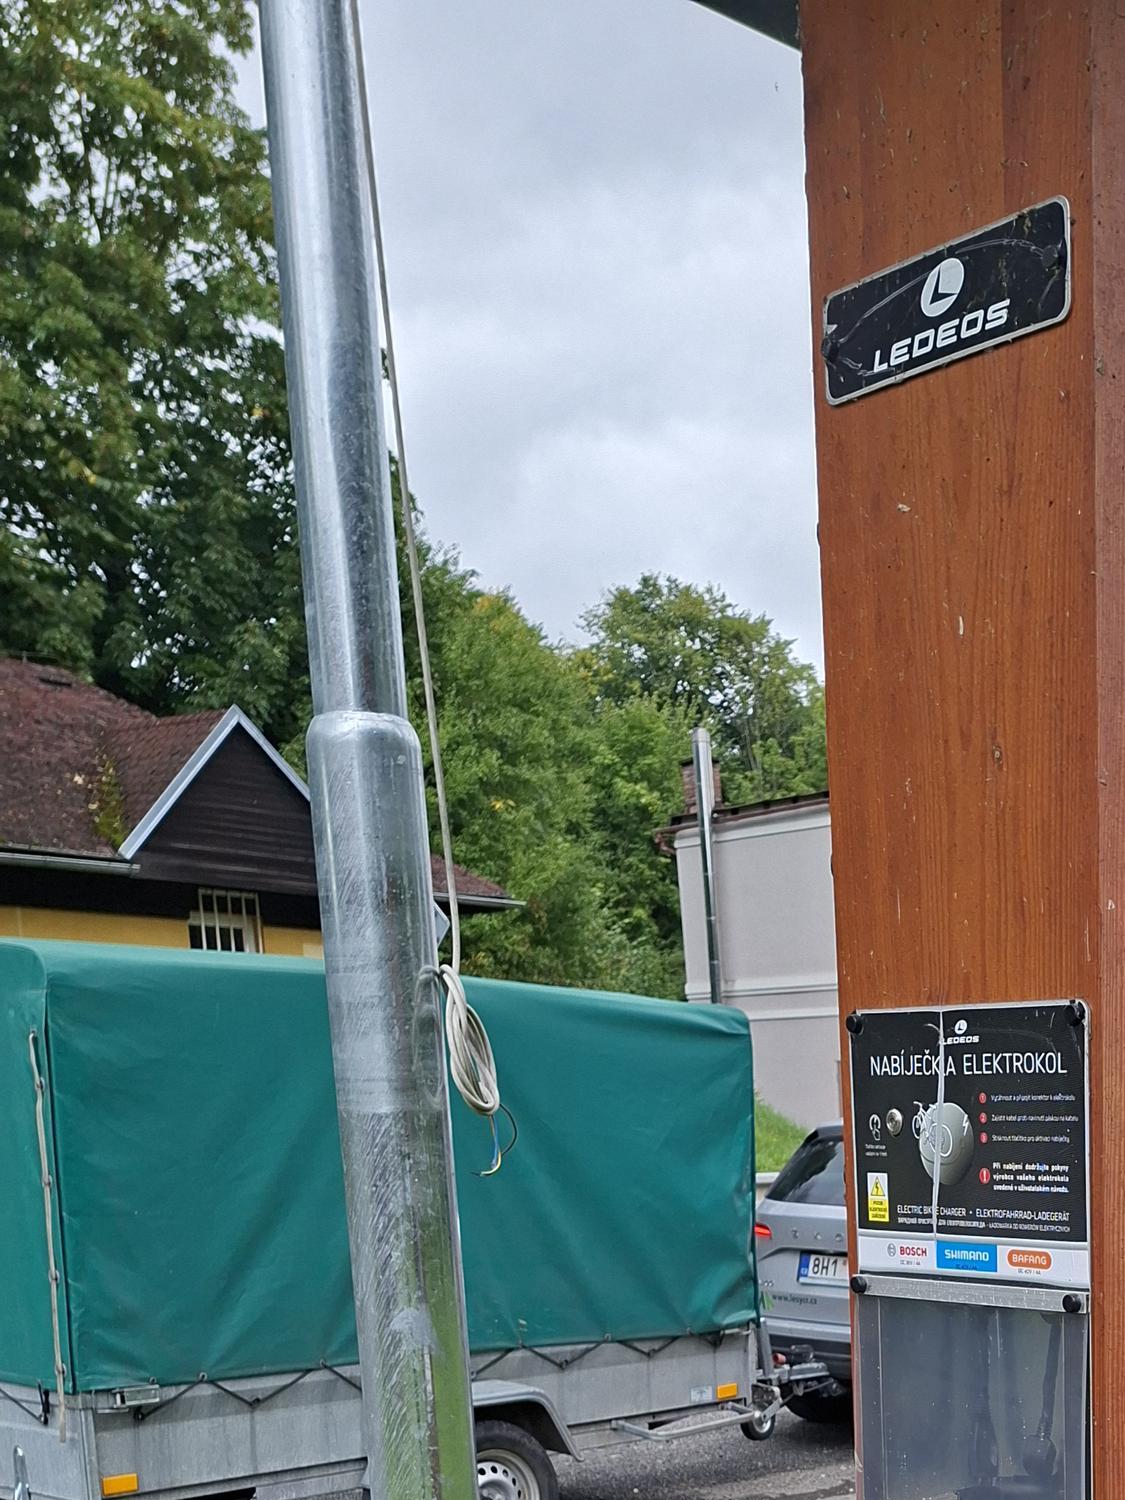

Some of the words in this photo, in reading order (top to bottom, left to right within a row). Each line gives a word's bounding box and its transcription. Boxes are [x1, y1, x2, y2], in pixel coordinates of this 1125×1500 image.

[873, 298, 1010, 373] LEDEOS
[870, 1049, 956, 1076] NABÍJEČKA
[963, 1052, 1067, 1075] ELEKTROKOL
[897, 1204, 923, 1215] ELECTRIC
[940, 1206, 967, 1217] CHARGER
[900, 1246, 927, 1257] BOSCH
[944, 1249, 990, 1261] SHIMANO
[1012, 1254, 1047, 1265] BAFANG
